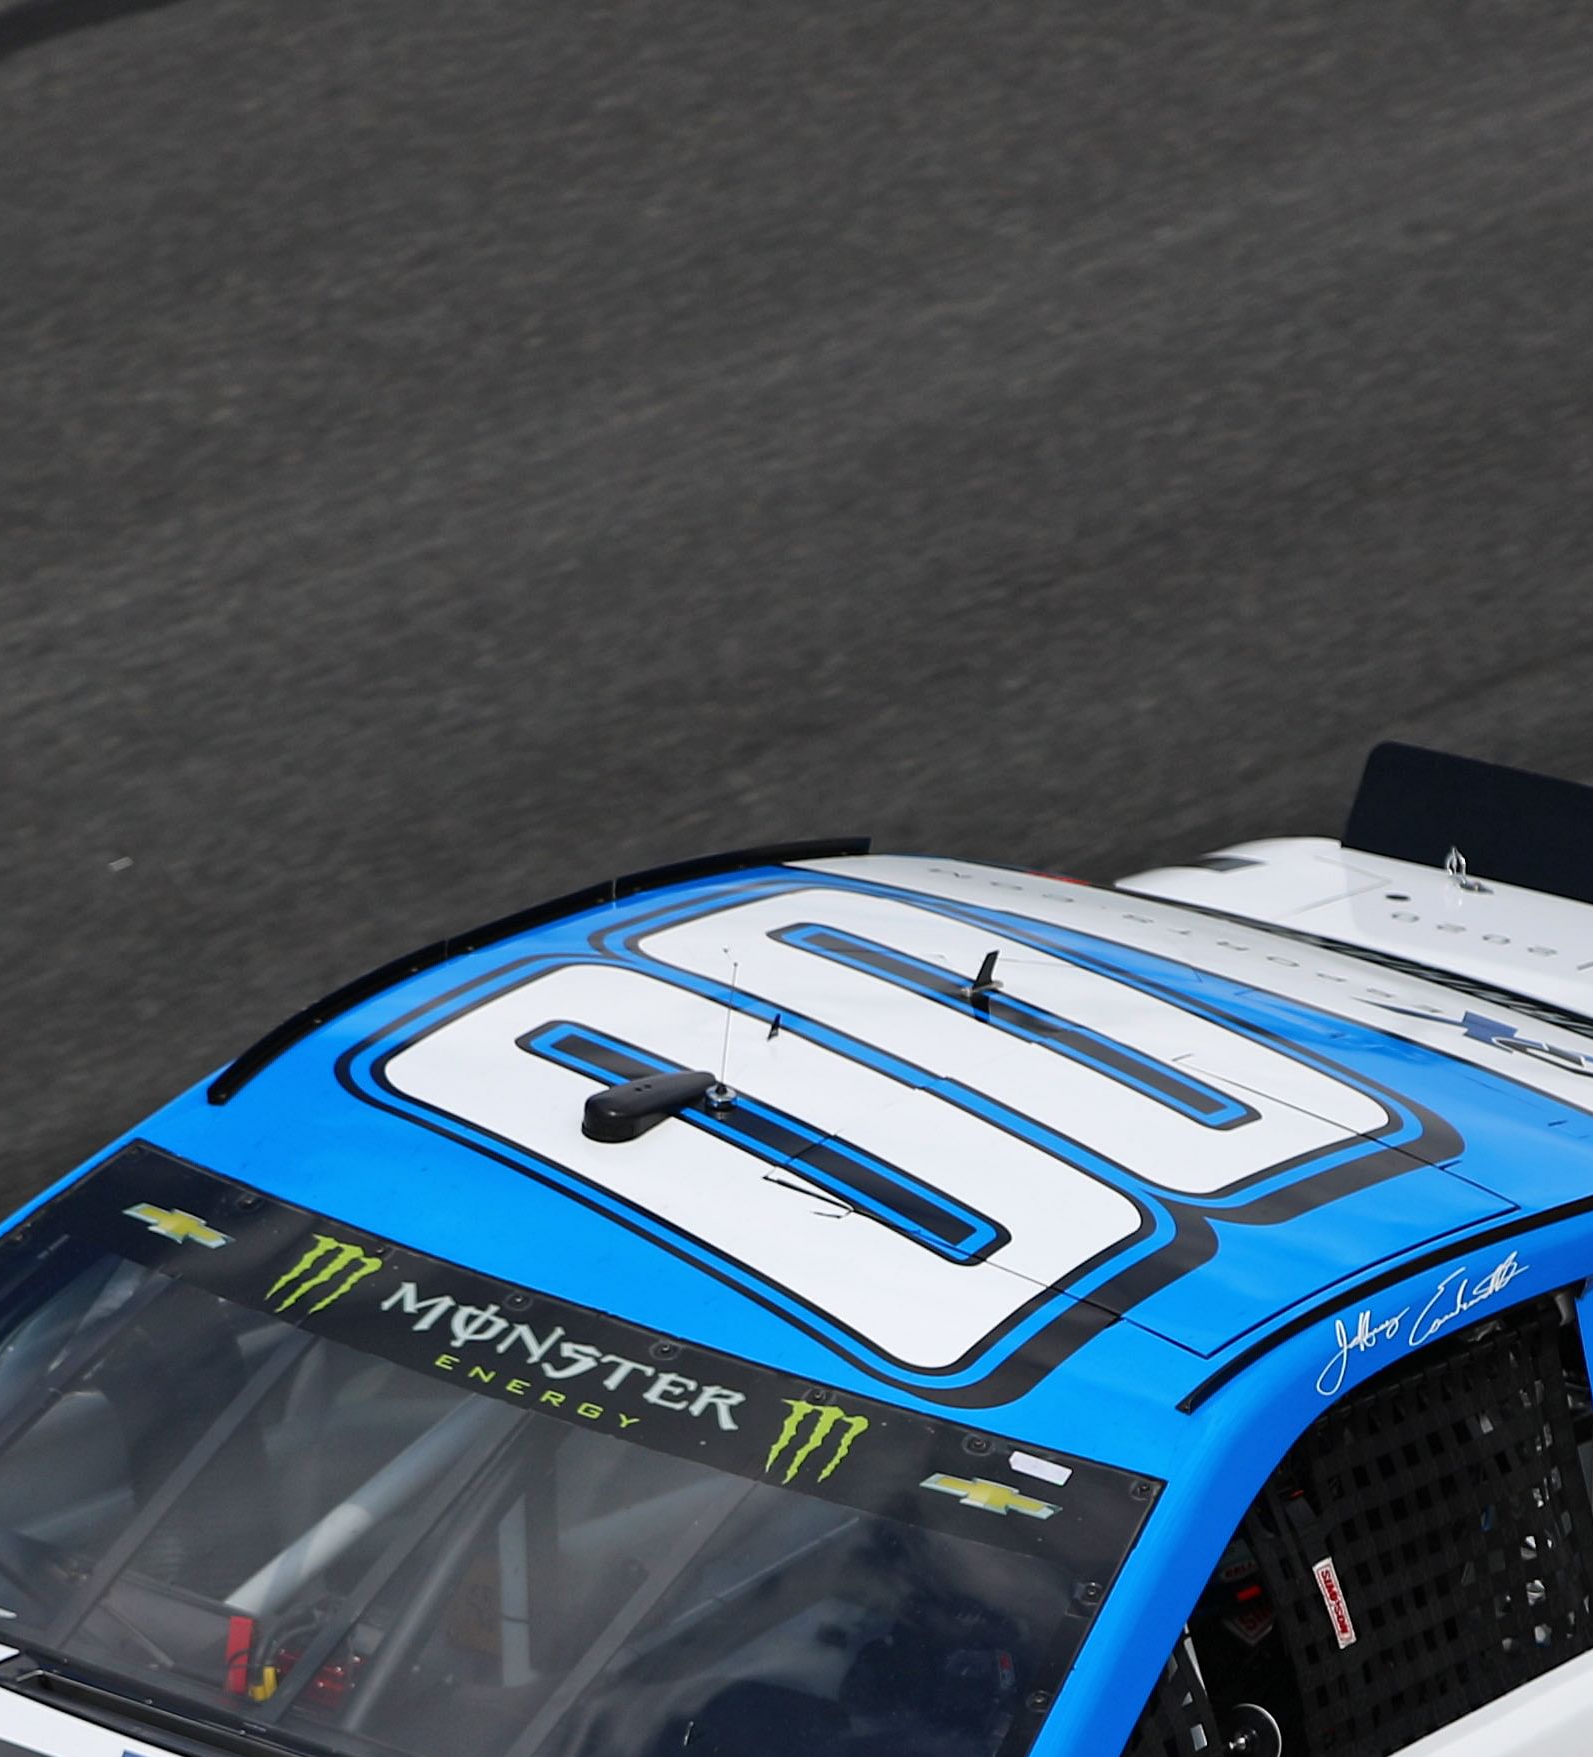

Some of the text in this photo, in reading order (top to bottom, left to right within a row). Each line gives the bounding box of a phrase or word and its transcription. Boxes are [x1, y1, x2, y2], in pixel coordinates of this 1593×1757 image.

[380, 1280, 747, 1432] MONSTER
[434, 1353, 640, 1429] ENERGY
[1320, 1569, 1350, 1634] SIMPSON
